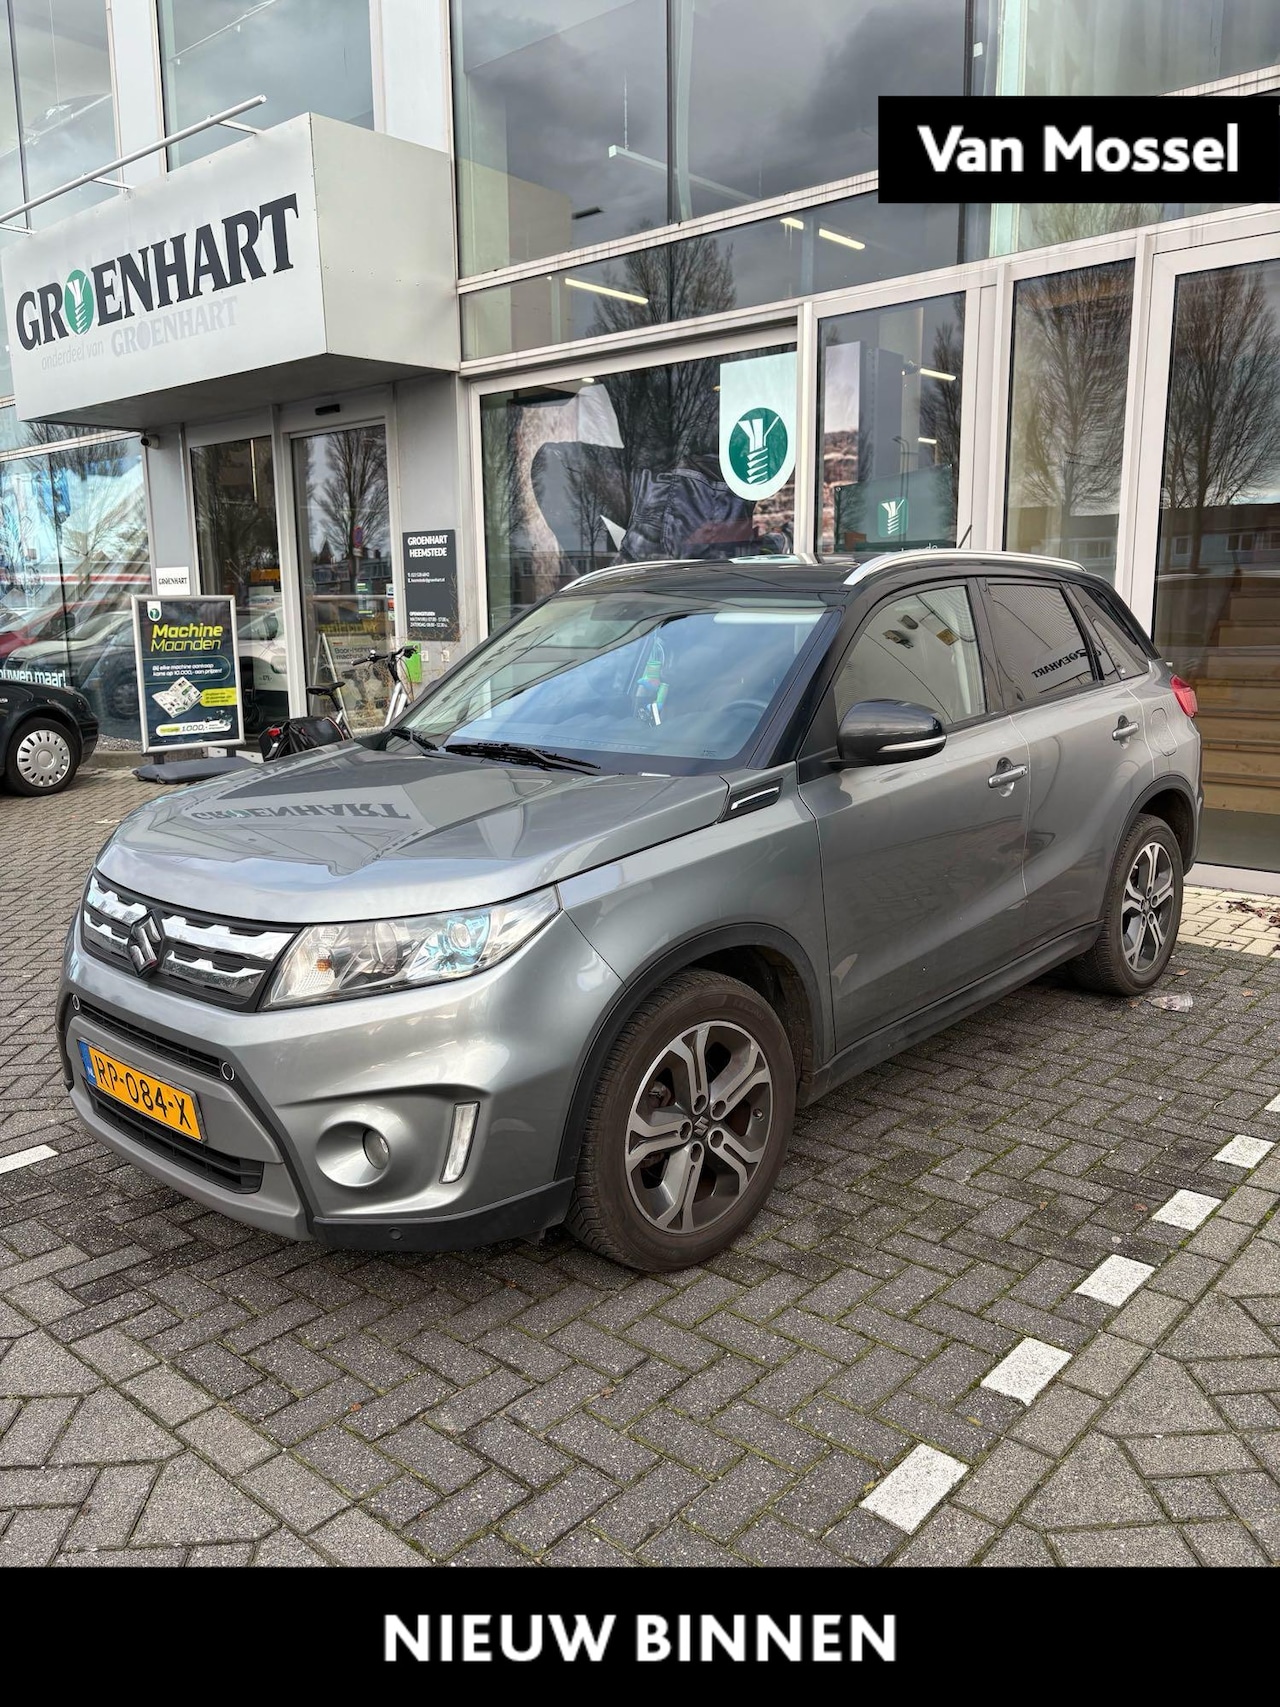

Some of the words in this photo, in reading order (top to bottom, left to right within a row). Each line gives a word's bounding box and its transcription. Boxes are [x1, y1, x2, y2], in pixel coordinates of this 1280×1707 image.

[16, 193, 299, 351] GROENHART
[41, 342, 86, 371] onderdeel
[86, 340, 105, 357] van
[407, 534, 448, 546] GROENHART
[409, 547, 447, 558] HEEMSTEDE
[152, 623, 223, 639] Machine
[150, 638, 221, 652] Maanden
[94, 1055, 192, 1130] RP-084-X
